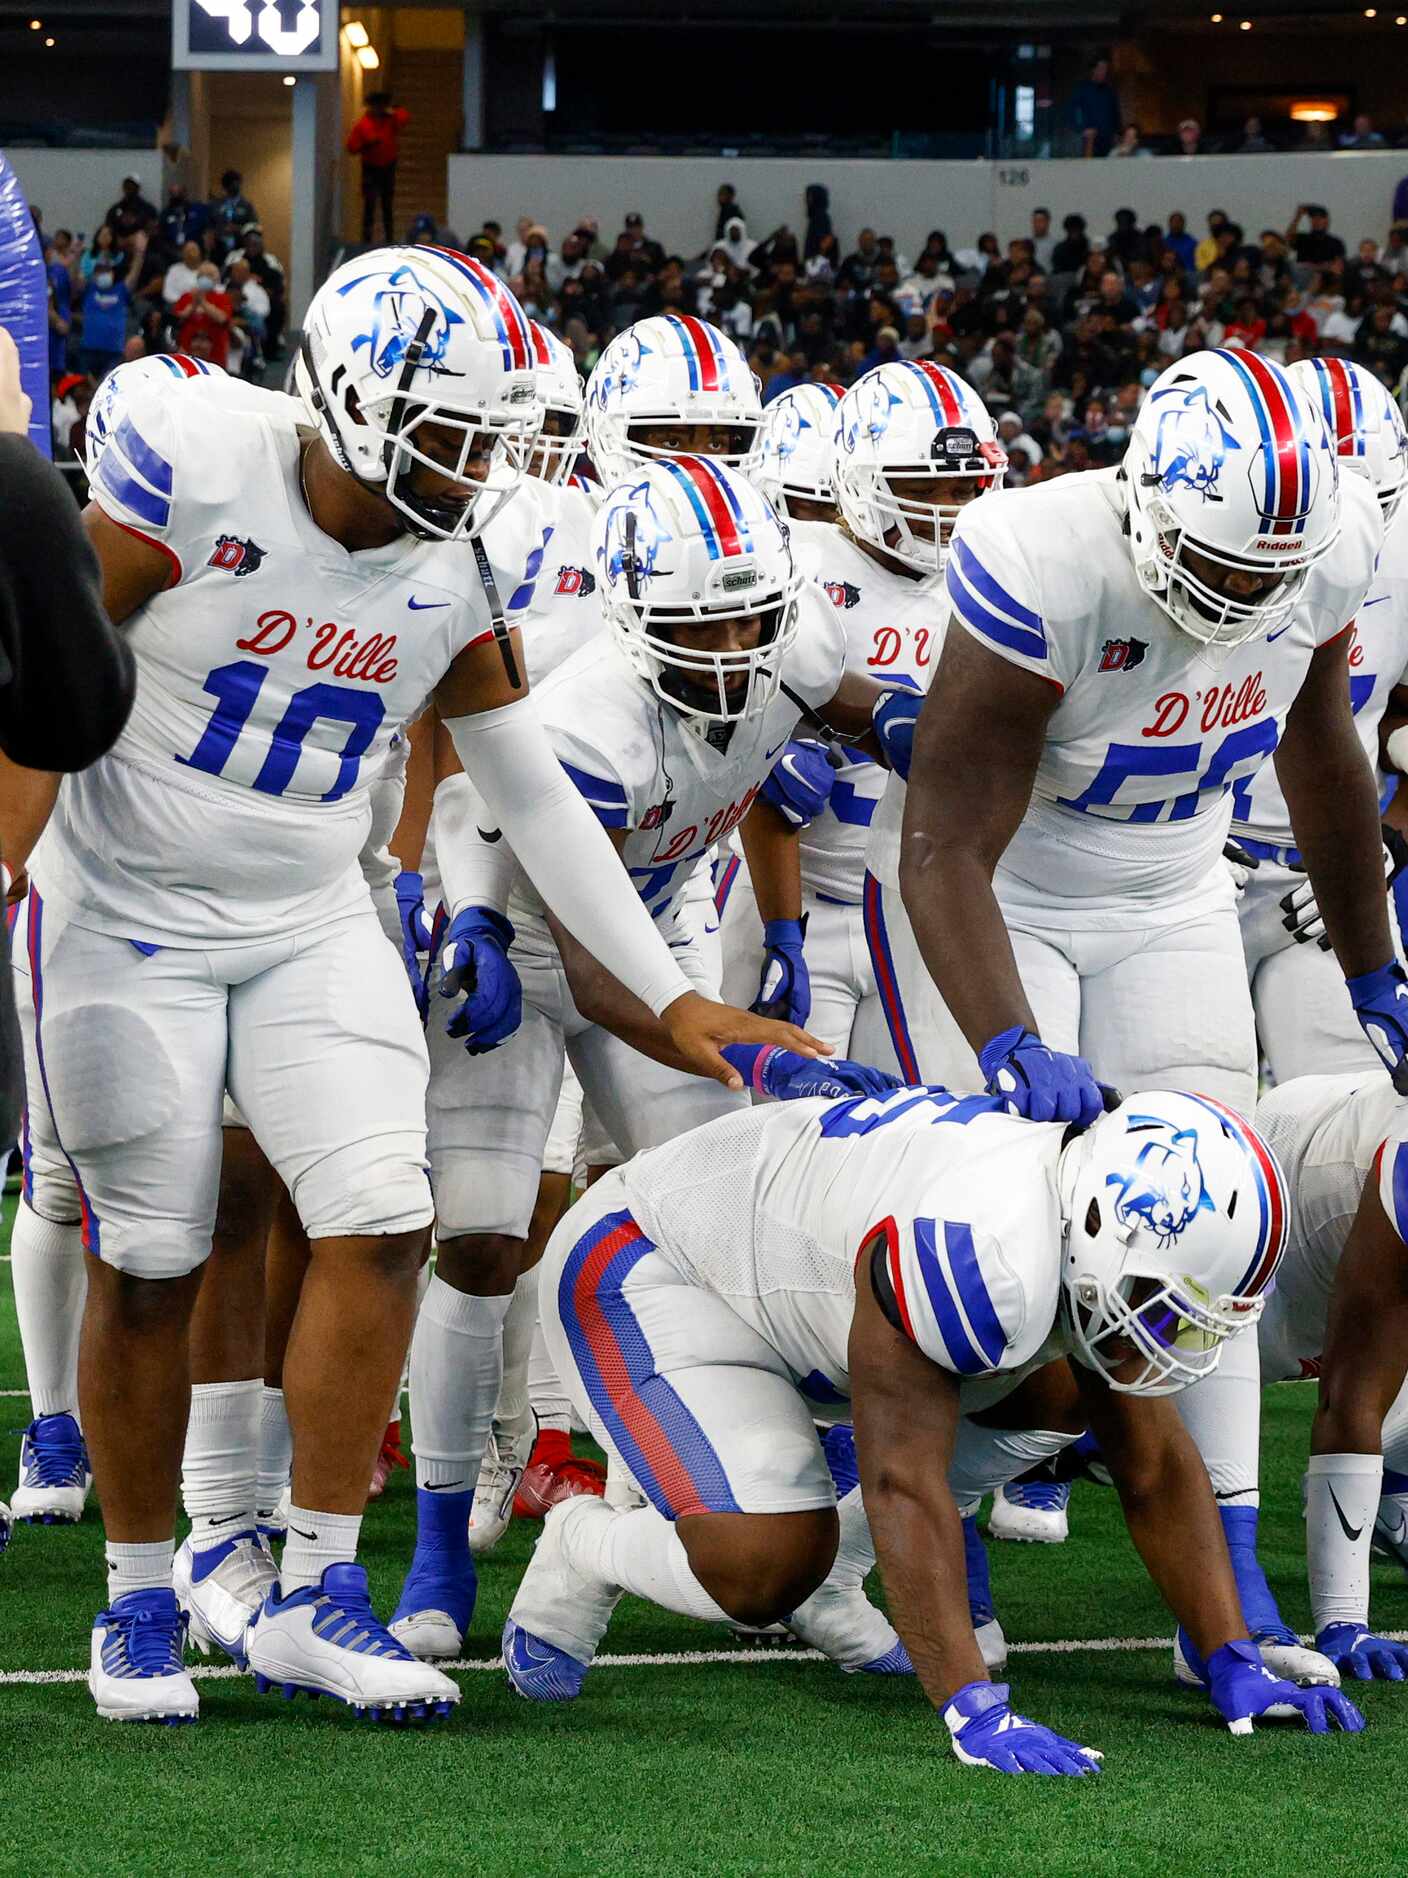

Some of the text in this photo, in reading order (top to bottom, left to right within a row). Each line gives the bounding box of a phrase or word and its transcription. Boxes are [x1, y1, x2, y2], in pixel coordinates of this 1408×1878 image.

[1256, 540, 1302, 551] Riddell
[236, 609, 398, 683] D'Ville
[174, 660, 386, 802] 10
[1141, 671, 1267, 738] D'Ville
